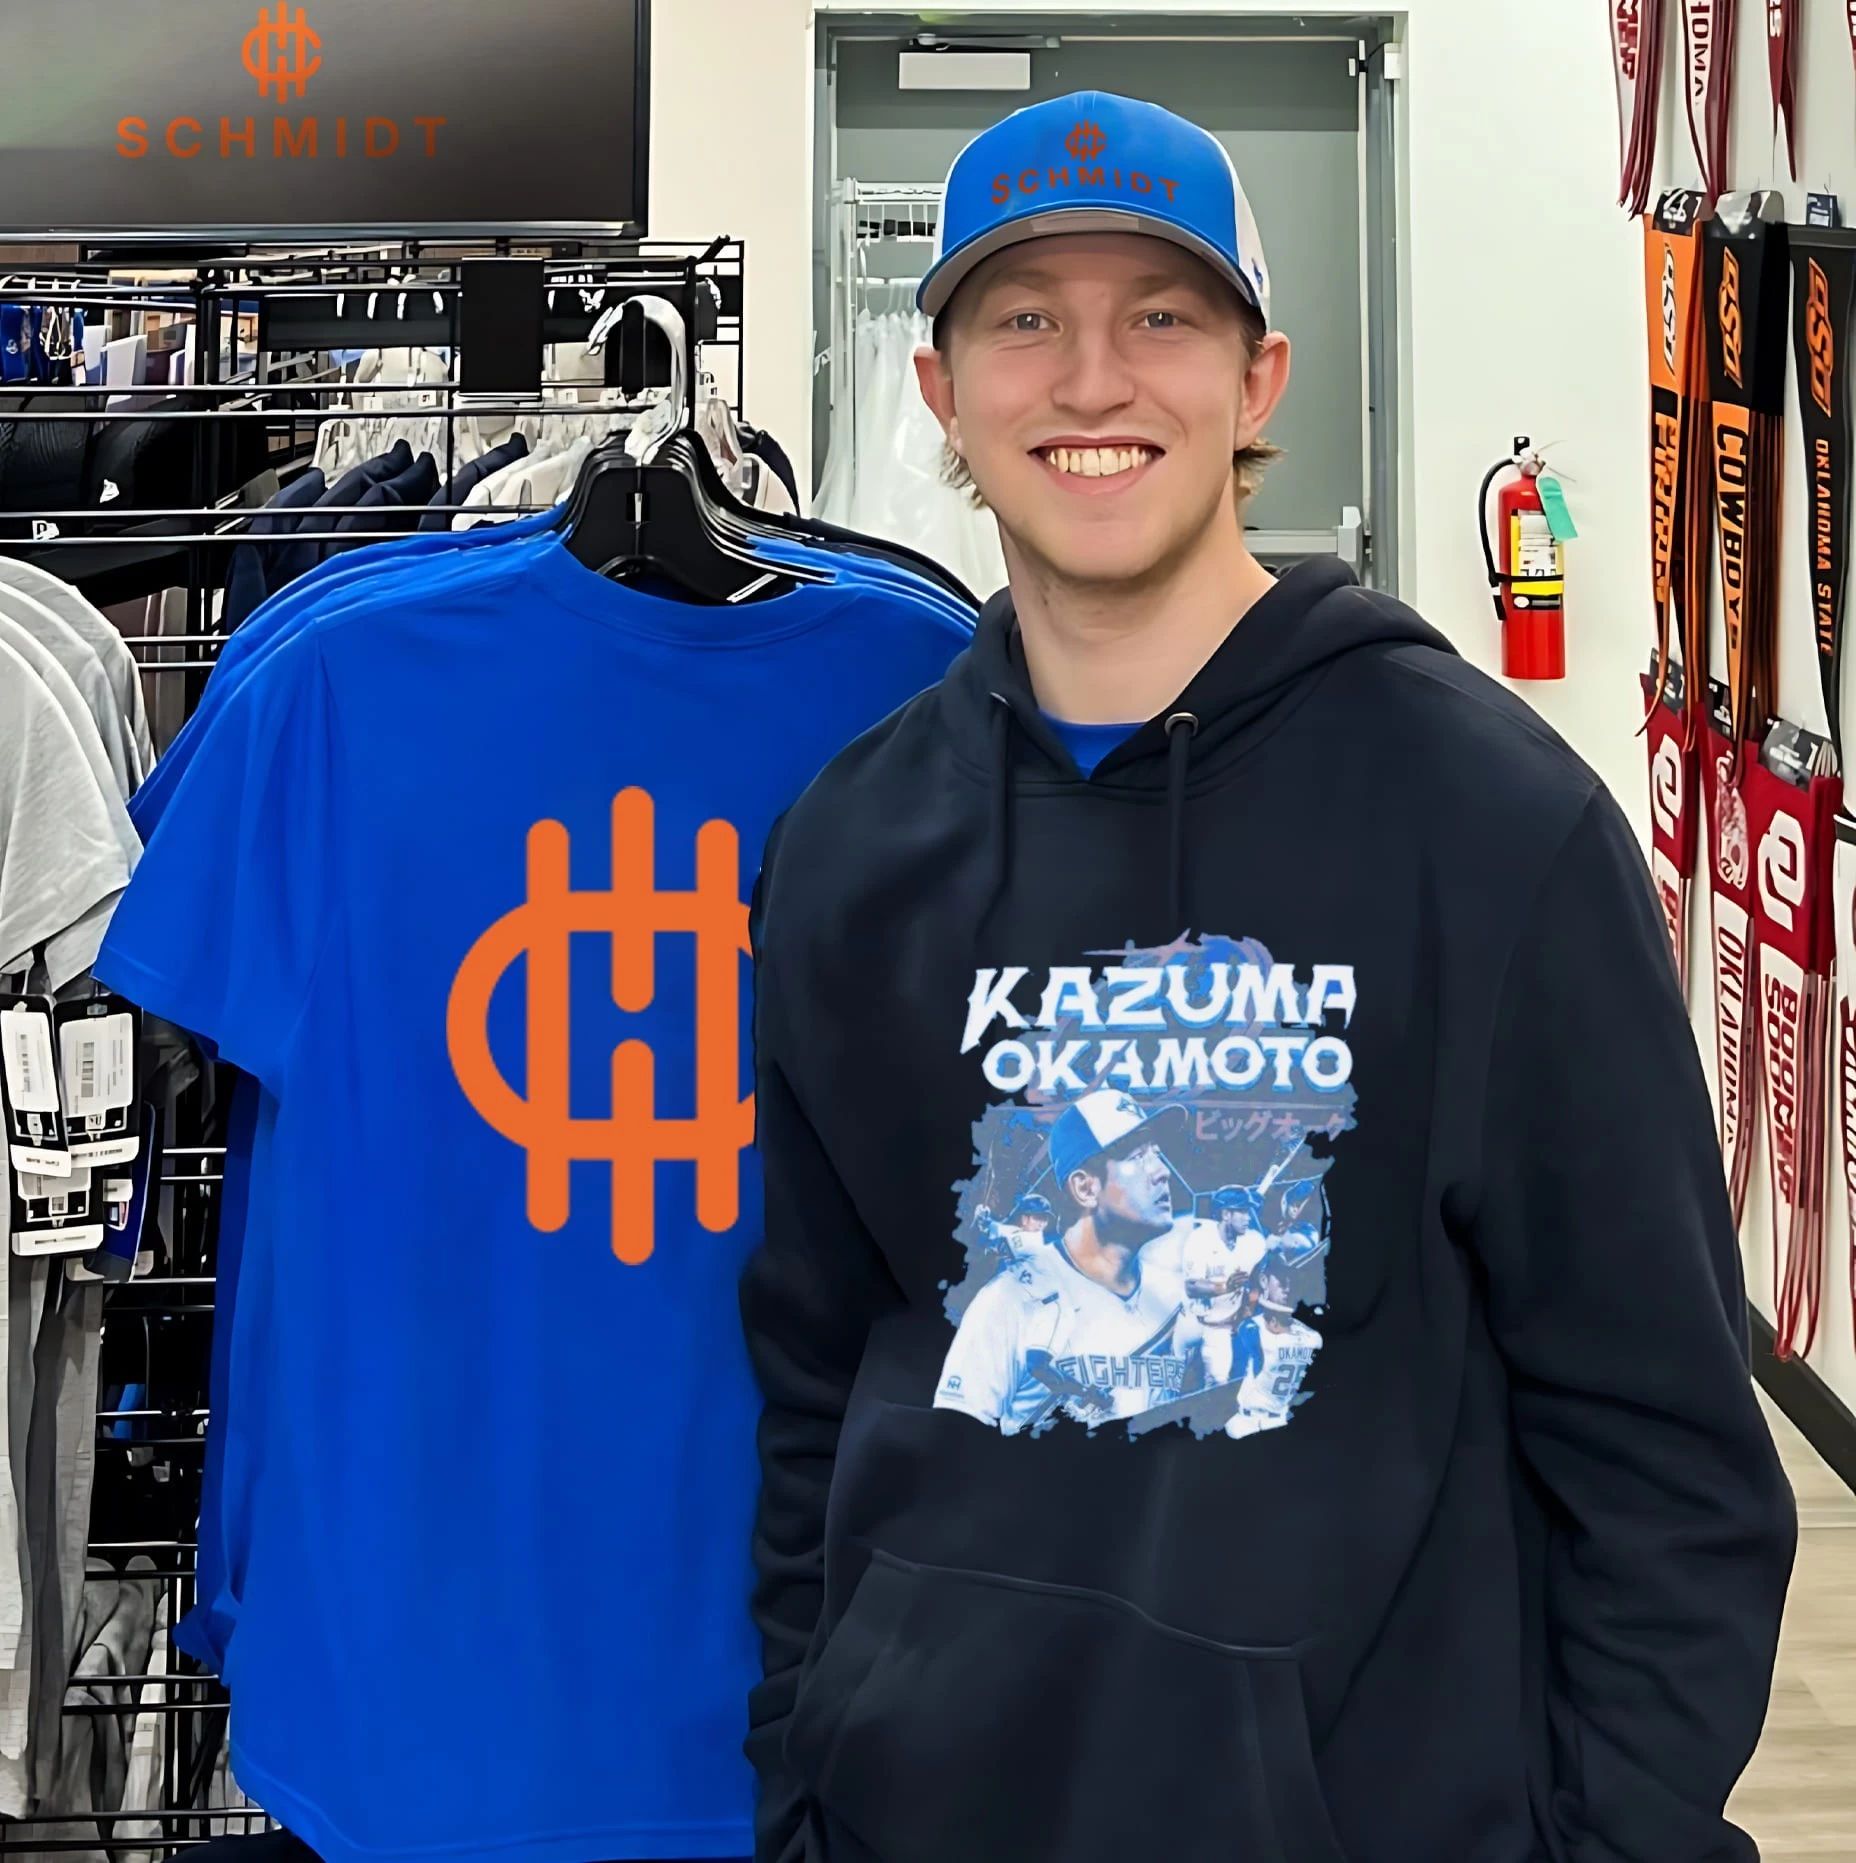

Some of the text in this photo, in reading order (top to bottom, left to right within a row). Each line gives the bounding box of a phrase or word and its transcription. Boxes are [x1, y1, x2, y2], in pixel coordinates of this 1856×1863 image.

[115, 116, 448, 159] SCHMIDT
[991, 166, 1181, 205] SCHMIDT
[960, 963, 1357, 1055] KAZUMA
[982, 1035, 1354, 1094] OKAMOTO
